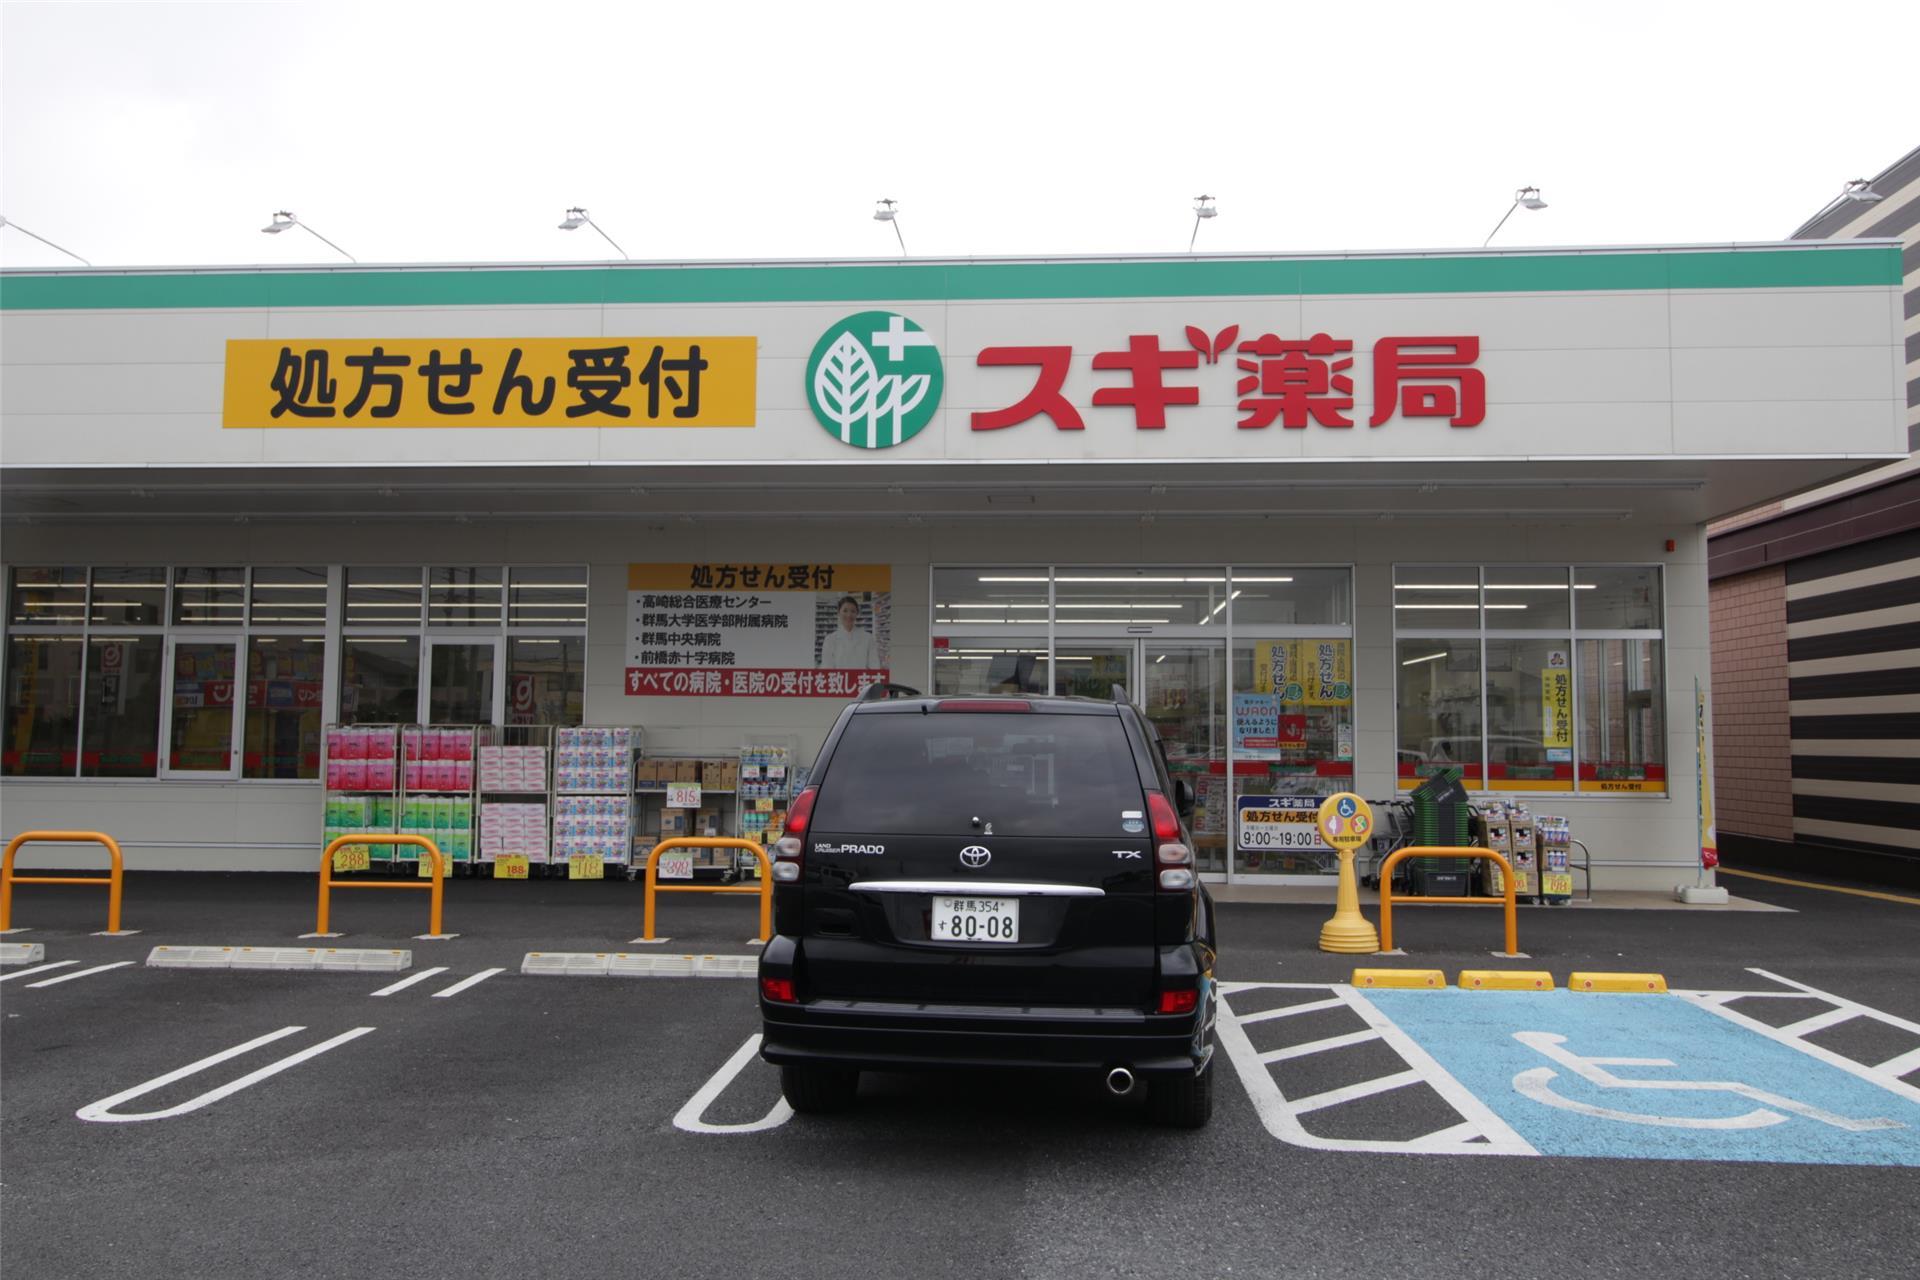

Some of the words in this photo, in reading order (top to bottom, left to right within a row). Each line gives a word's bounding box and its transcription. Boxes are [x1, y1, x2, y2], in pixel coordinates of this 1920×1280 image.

[269, 344, 709, 420] 処方せん受付
[970, 323, 1487, 431] スギ薬局
[691, 565, 835, 589] 処方せん受付
[1319, 644, 1334, 698] 処方せん
[1554, 673, 1569, 743] 処方せん受付
[675, 790, 696, 804] 815
[1269, 797, 1315, 808] スギ薬局
[840, 844, 885, 855] PRADO
[1111, 850, 1142, 860] TX
[340, 852, 366, 867] 288
[506, 865, 526, 875] 188
[951, 914, 1014, 939] 80-08
